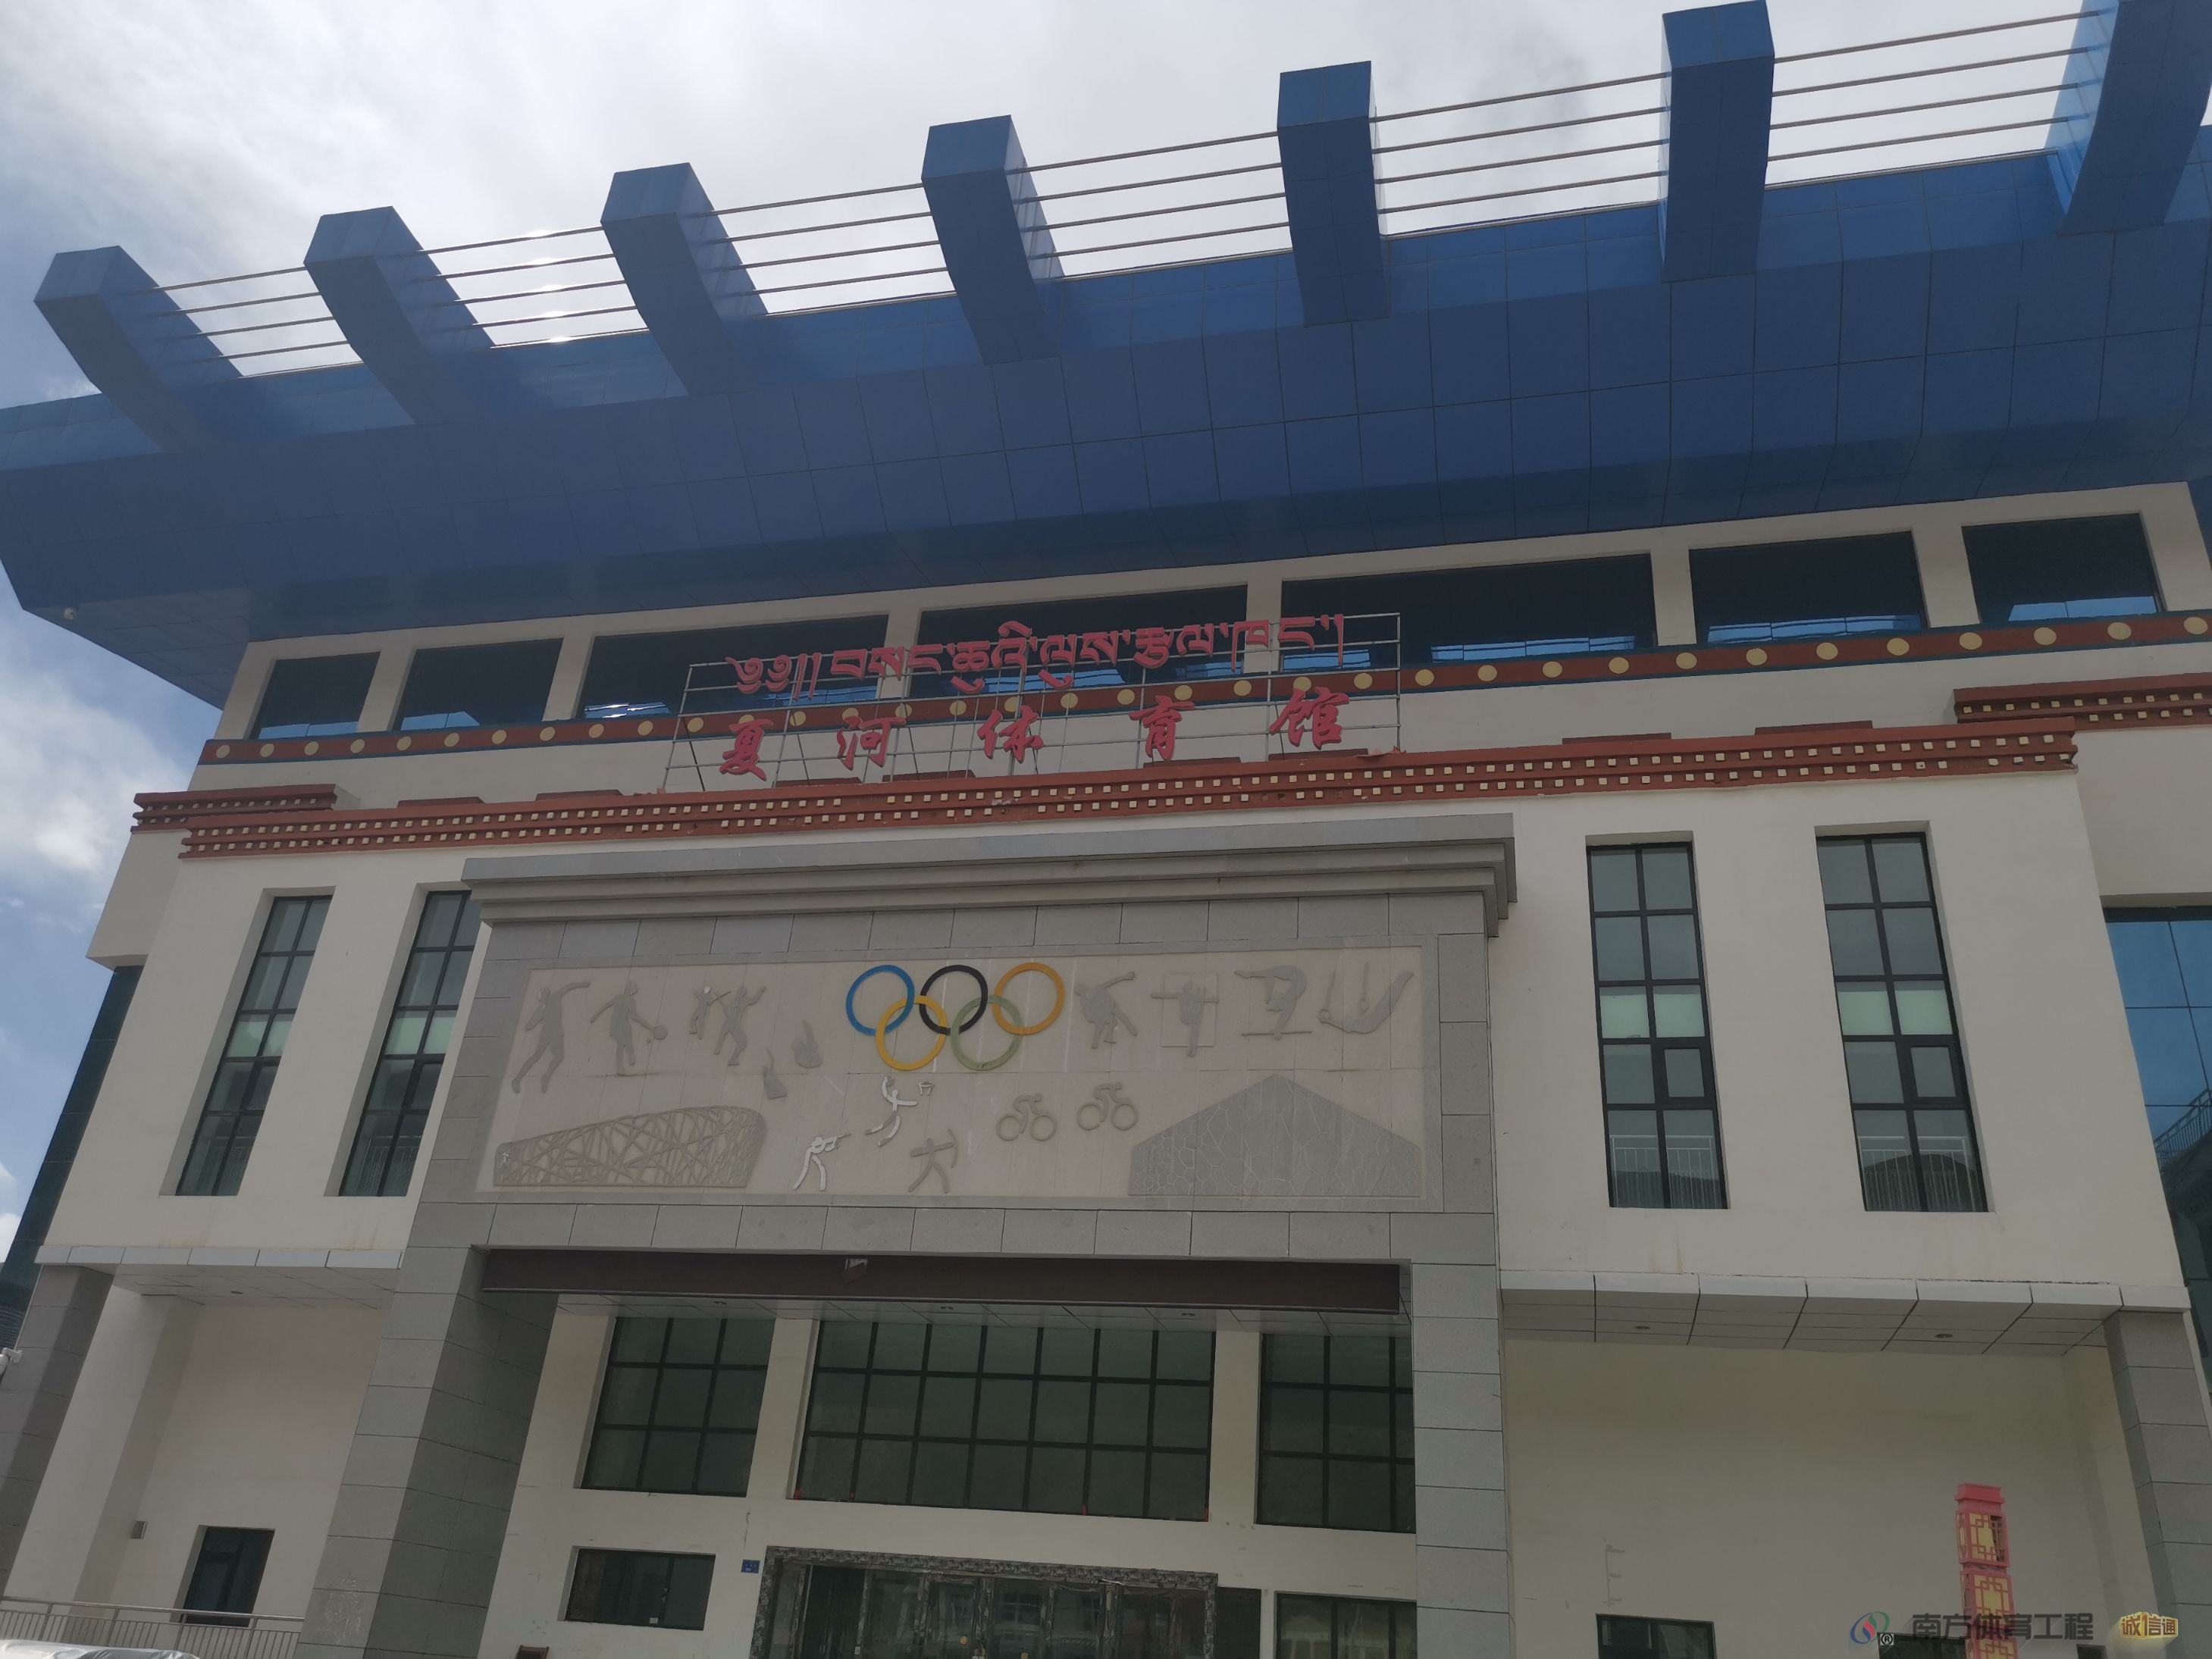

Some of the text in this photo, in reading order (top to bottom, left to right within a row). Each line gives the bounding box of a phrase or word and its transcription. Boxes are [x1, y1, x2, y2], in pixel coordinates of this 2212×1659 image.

[719, 686, 1350, 781] 夏河体育馆
